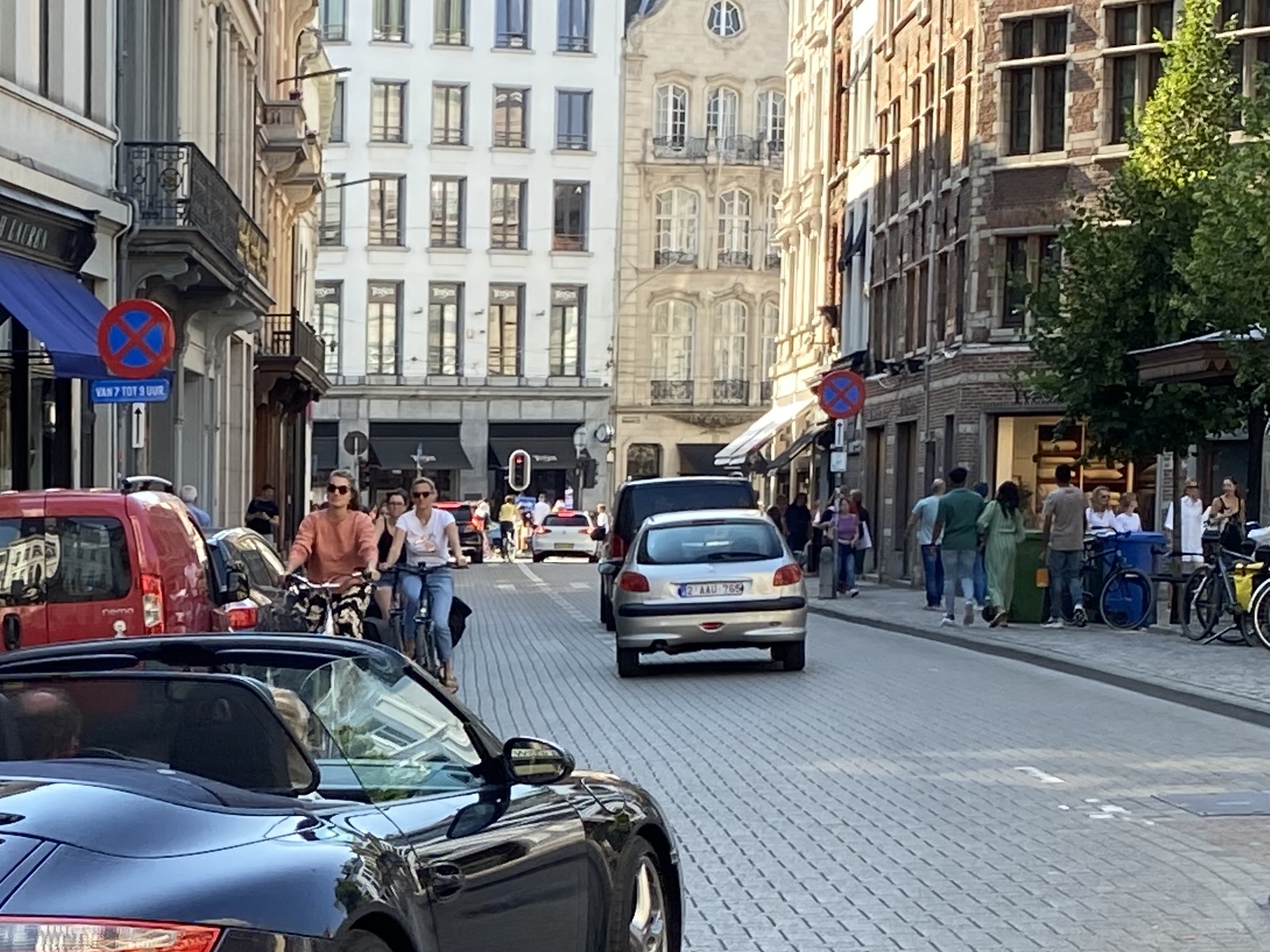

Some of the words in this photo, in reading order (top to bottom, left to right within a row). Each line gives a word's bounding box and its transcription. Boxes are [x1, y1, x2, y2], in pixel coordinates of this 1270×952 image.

[95, 386, 113, 397] VAN
[114, 386, 121, 397] 7
[121, 385, 137, 397] TOT
[146, 384, 164, 396] UUR
